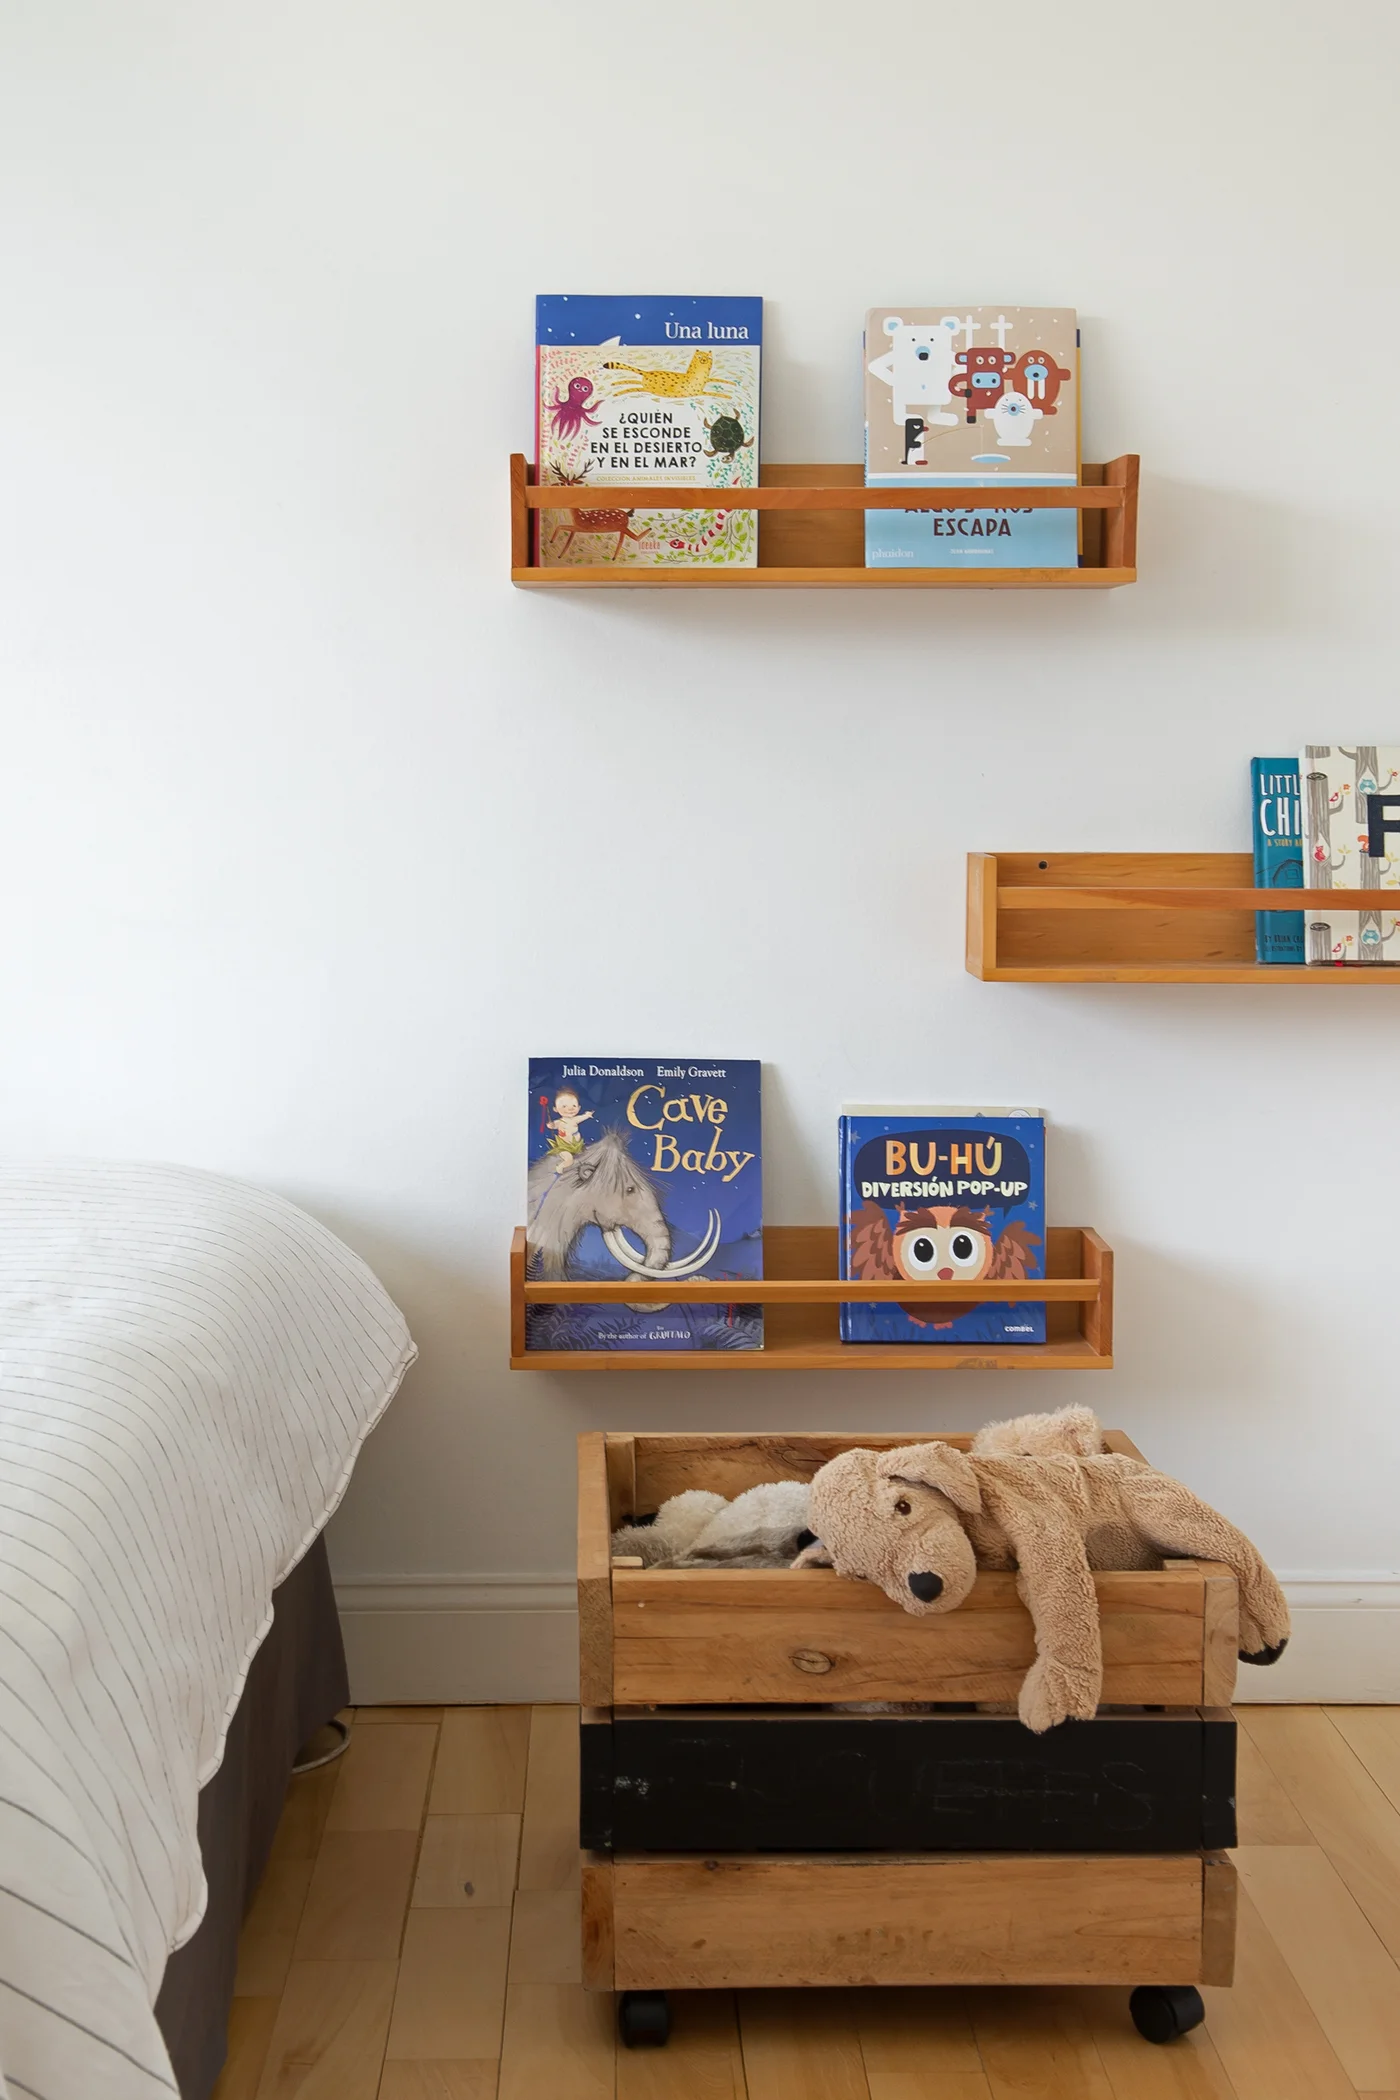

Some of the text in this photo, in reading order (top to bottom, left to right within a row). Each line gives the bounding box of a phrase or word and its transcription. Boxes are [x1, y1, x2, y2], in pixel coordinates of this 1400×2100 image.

[664, 321, 749, 339] Una luna
[619, 409, 673, 424] ¿QUIÉN
[602, 427, 691, 439] SE ESCONDE
[591, 442, 702, 453] EN EL DESIERTO
[597, 456, 697, 468] Y EN EL MAR?
[933, 518, 1012, 537] ESCAPA
[872, 547, 914, 560] phaidon
[562, 1065, 726, 1079] Julia Donaldson Emily Gravett
[626, 1084, 728, 1131] Cave
[651, 1126, 756, 1182] Baby
[885, 1135, 1003, 1176] BU-HÚ
[861, 1175, 1028, 1198] DIVERSIÓN POP-UP
[607, 1331, 617, 1339] the
[618, 1331, 639, 1339] author
